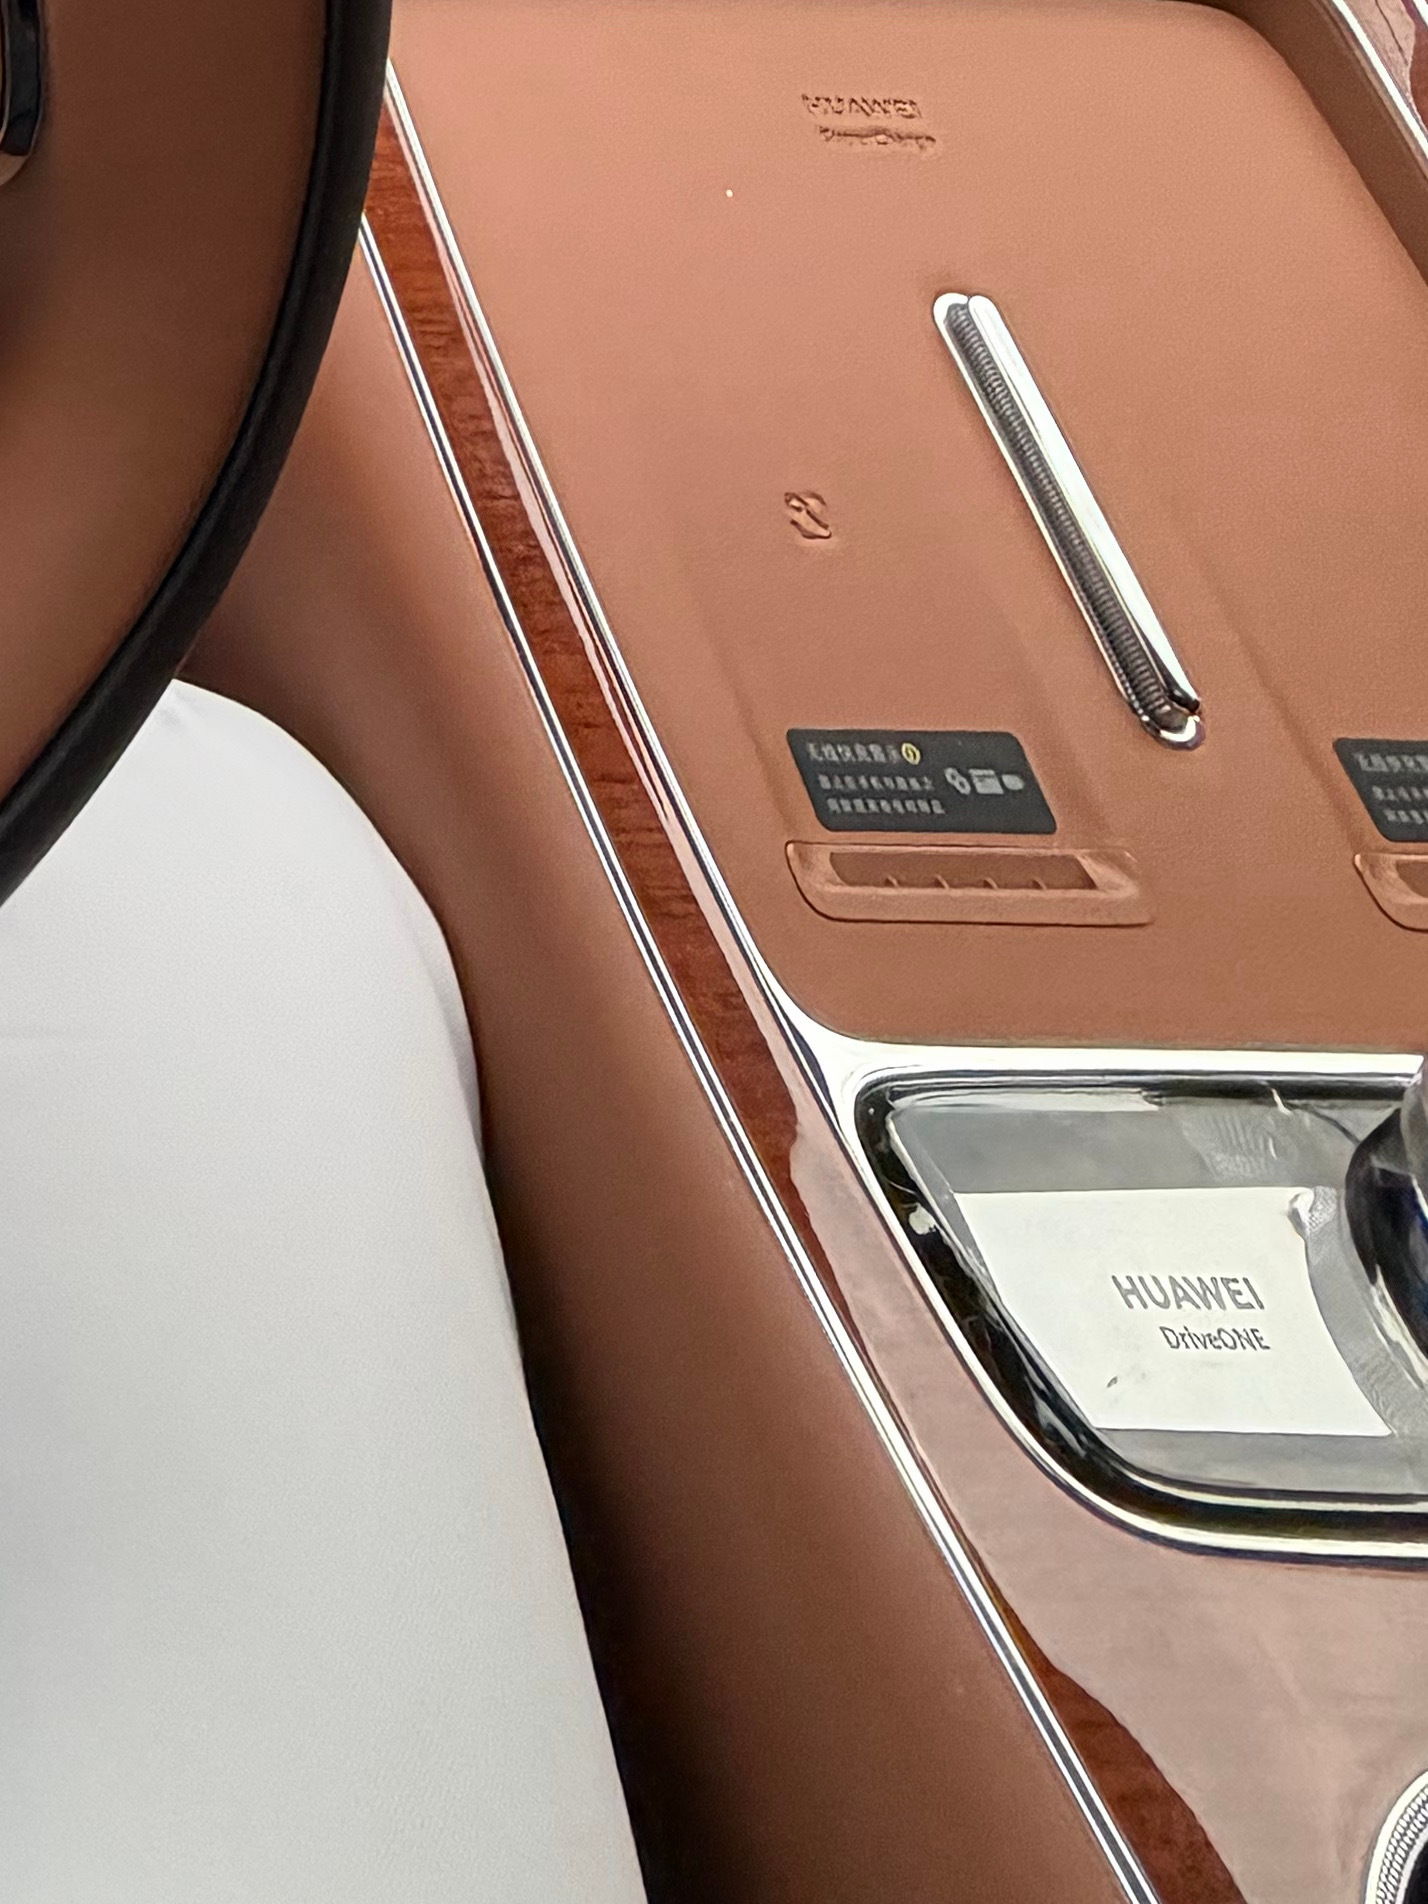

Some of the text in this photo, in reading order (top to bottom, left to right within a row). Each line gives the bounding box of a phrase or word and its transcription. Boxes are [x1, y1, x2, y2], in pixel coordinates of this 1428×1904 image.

[801, 94, 922, 119] HUAWEI
[1110, 1274, 1265, 1311] HUAWEI
[1159, 1324, 1270, 1352] DriveONE
